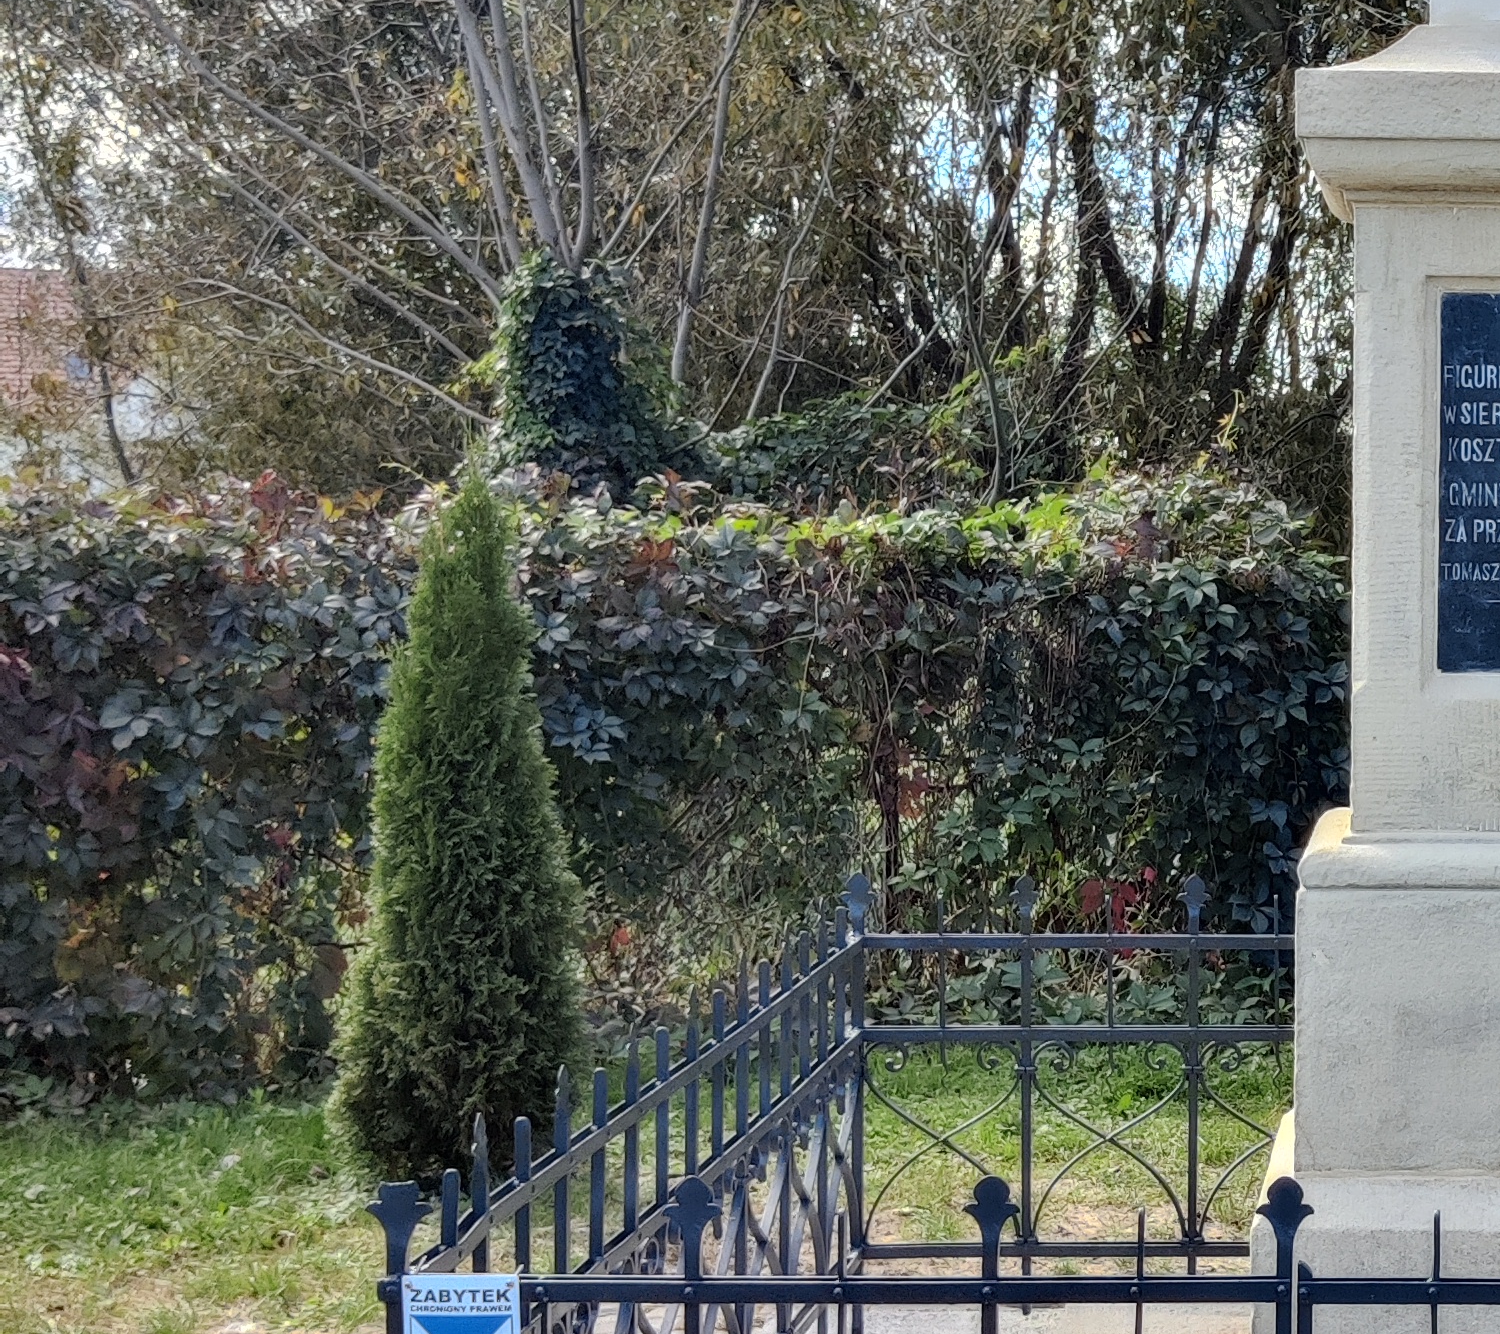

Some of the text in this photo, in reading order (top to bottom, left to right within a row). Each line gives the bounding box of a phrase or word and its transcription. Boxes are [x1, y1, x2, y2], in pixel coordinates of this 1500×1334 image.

[1444, 518, 1468, 543] ZA
[410, 1289, 511, 1303] ZABYTEK
[410, 1305, 512, 1313] CHRONIONY PRAWEM
